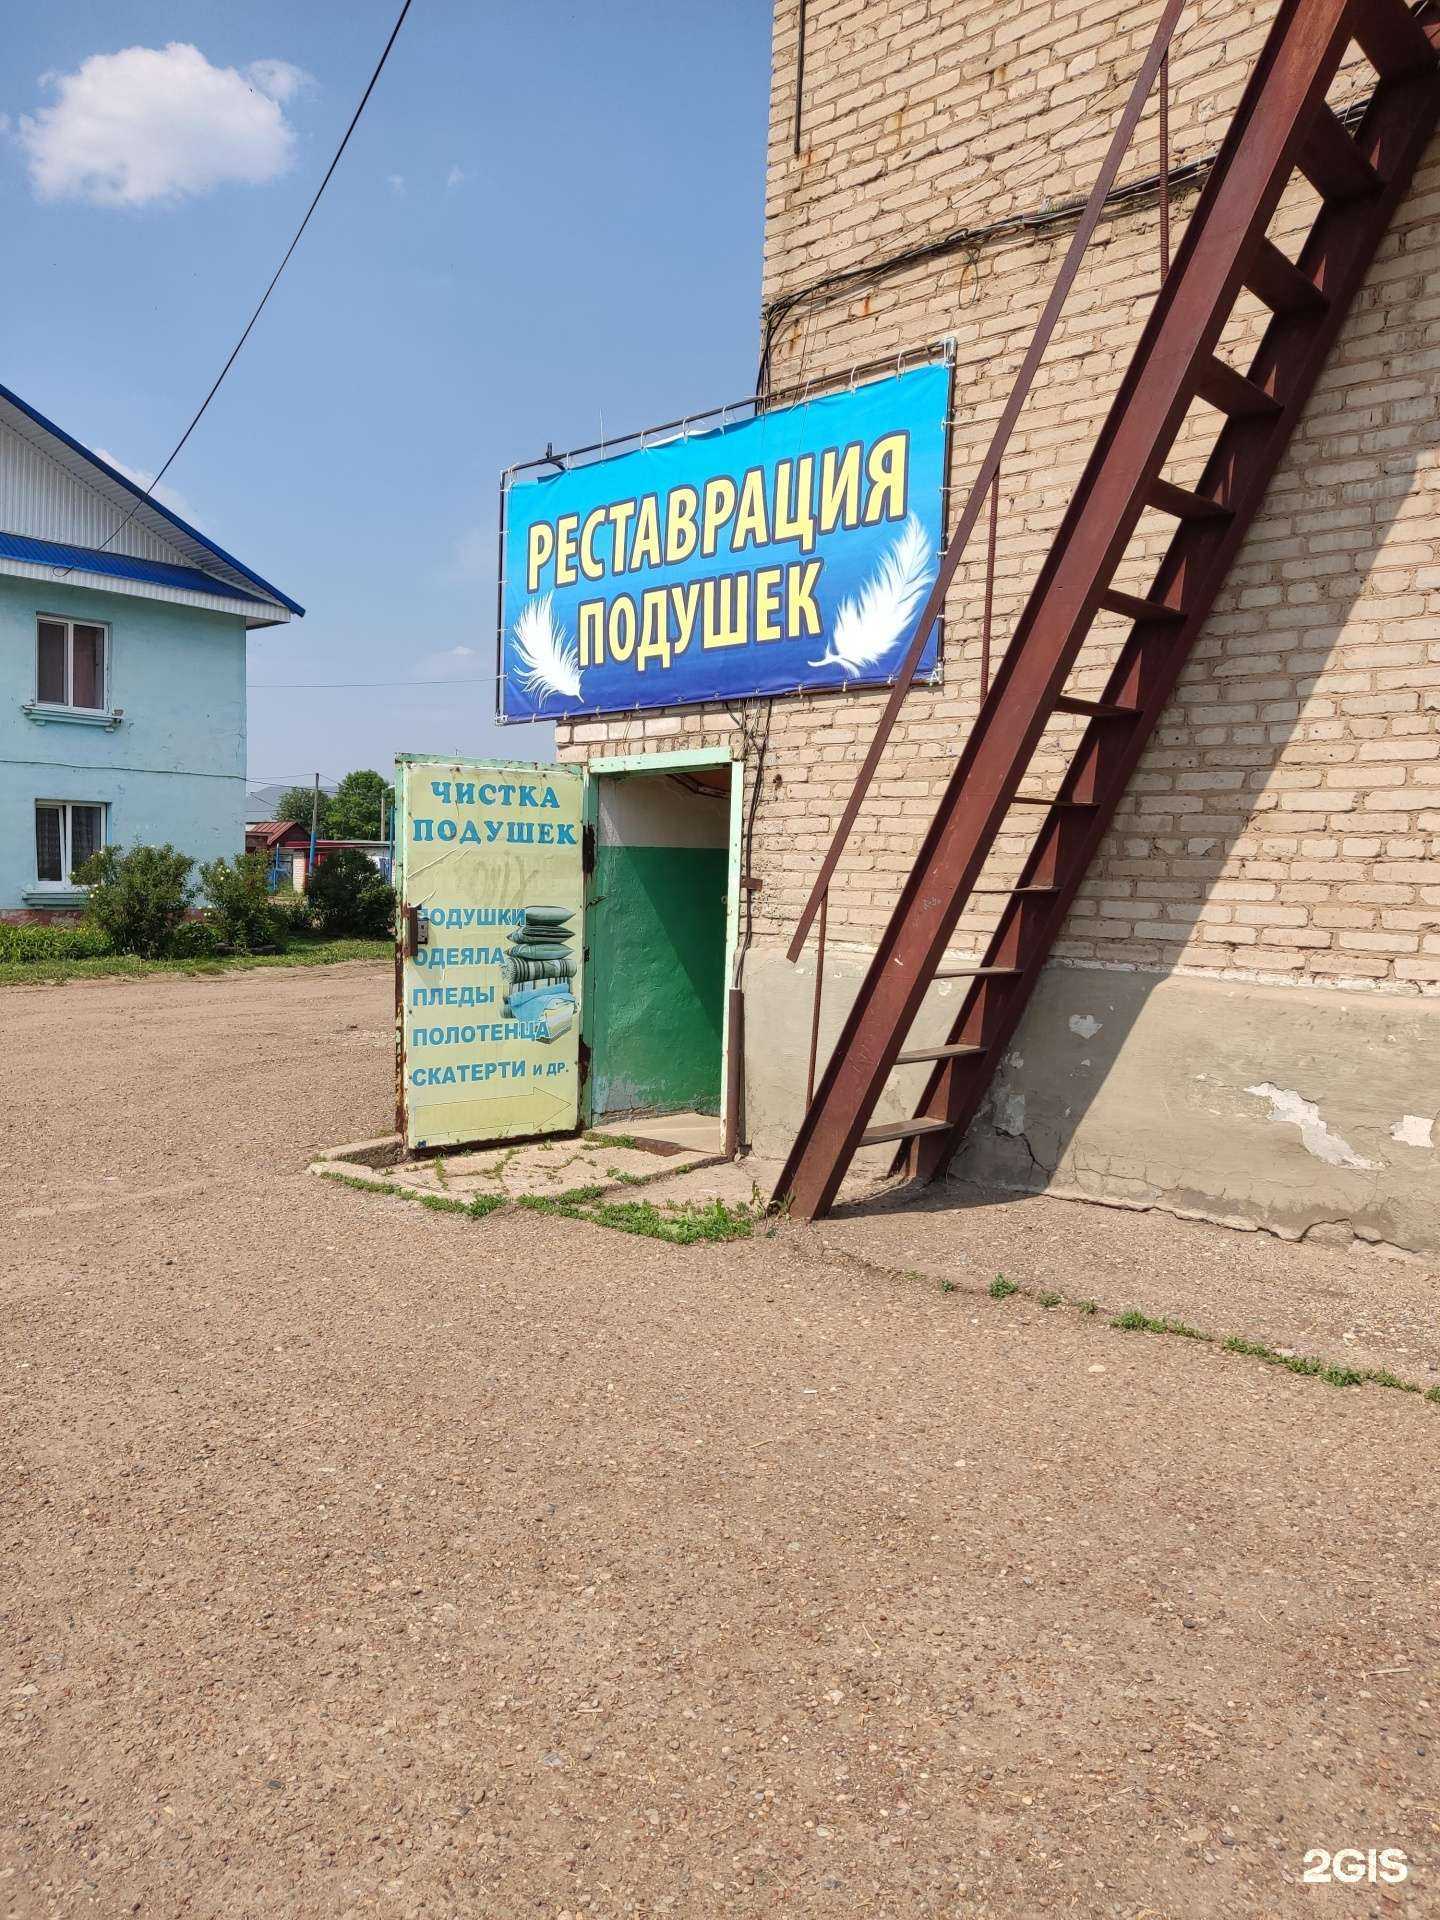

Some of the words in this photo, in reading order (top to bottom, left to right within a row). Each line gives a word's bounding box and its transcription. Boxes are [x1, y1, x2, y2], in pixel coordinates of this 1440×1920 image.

[527, 430, 910, 594] РЕСТАВРАЦИЯ
[577, 557, 824, 673] ПОДУШЕК
[431, 781, 560, 808] ЧИСТКА
[412, 819, 578, 845] ПОДУШЕК
[412, 947, 505, 969] ОДЕЯЛА
[412, 985, 495, 1007] ПЛЕДЫ
[412, 1021, 550, 1046] ПОЛОТЕНЦА
[412, 1060, 526, 1086] СКАТЕРТИ
